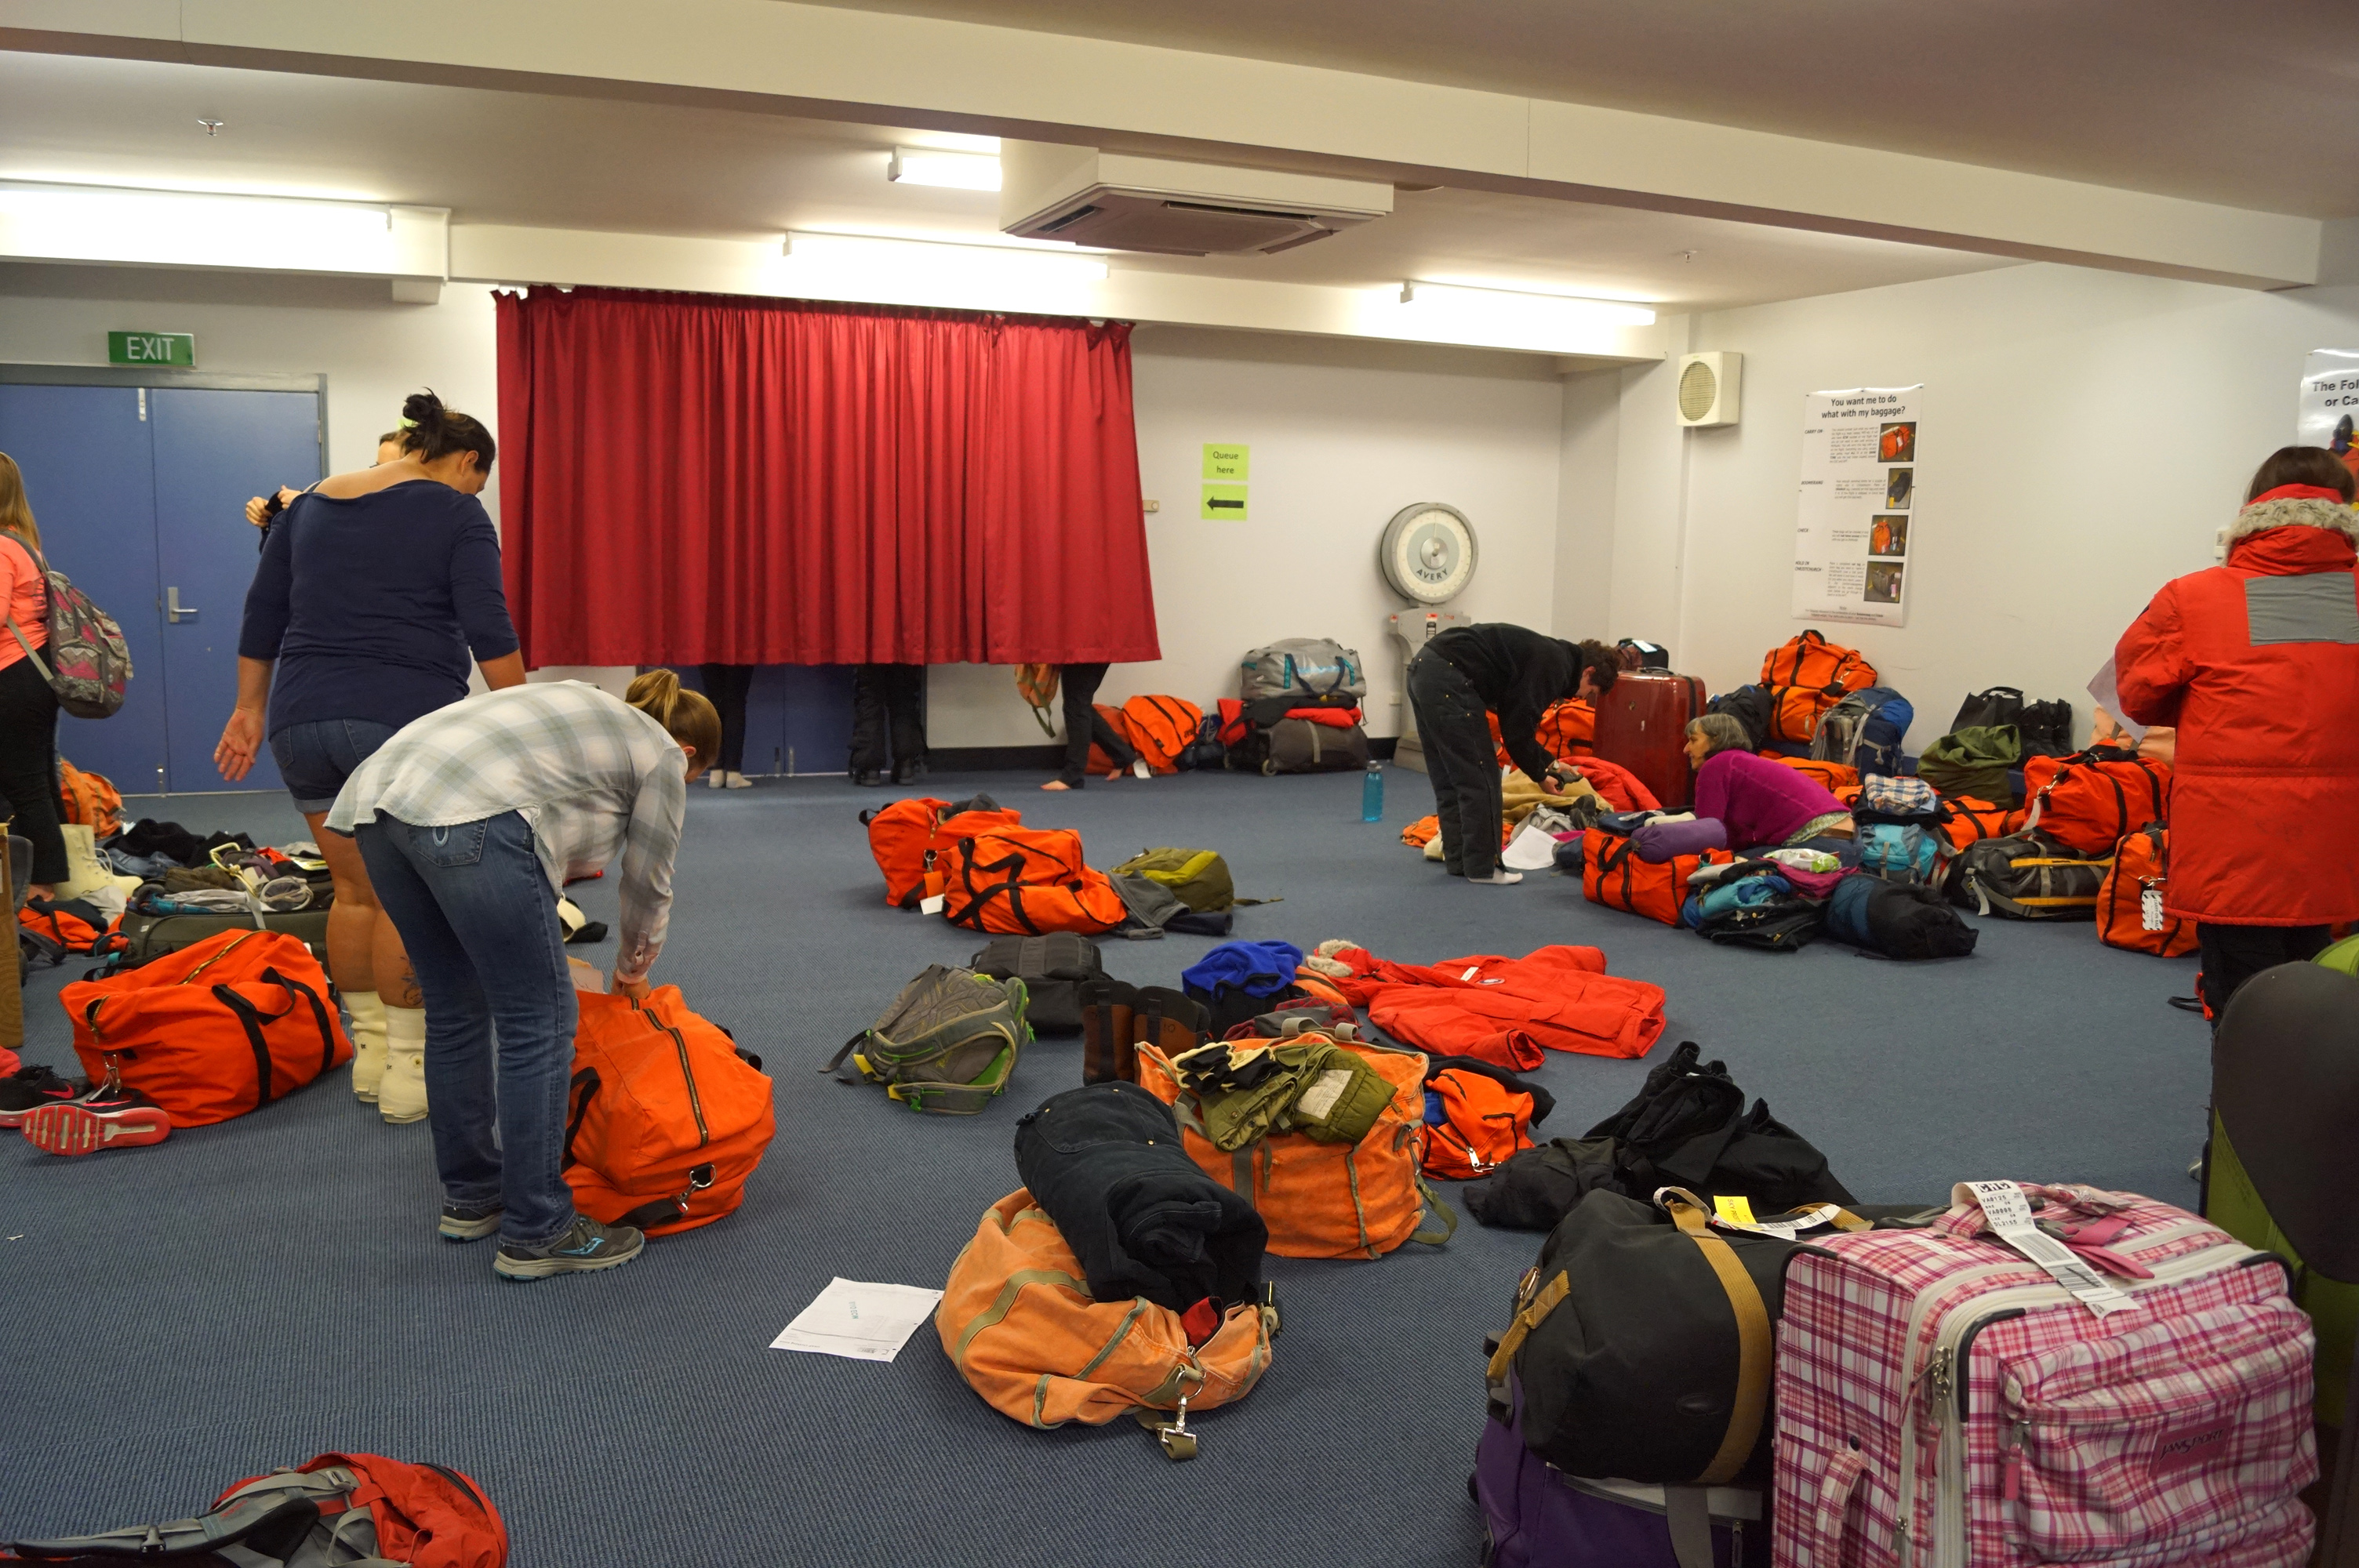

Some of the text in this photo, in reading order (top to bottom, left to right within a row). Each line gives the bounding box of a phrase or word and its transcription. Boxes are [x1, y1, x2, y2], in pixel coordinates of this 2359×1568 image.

[127, 336, 174, 360] EXIT
[2314, 381, 2335, 392] The
[1888, 394, 1896, 403] do
[2324, 398, 2338, 407] or
[1841, 409, 1856, 418] with
[1859, 409, 1869, 418] my
[1870, 405, 1906, 417] baggage?
[1212, 451, 1239, 459] Queue
[1416, 568, 1448, 580] AVERY
[1976, 1182, 2012, 1192] CHC
[1727, 1199, 1736, 1210] SKY
[2159, 1429, 2224, 1461] JANSPORT
